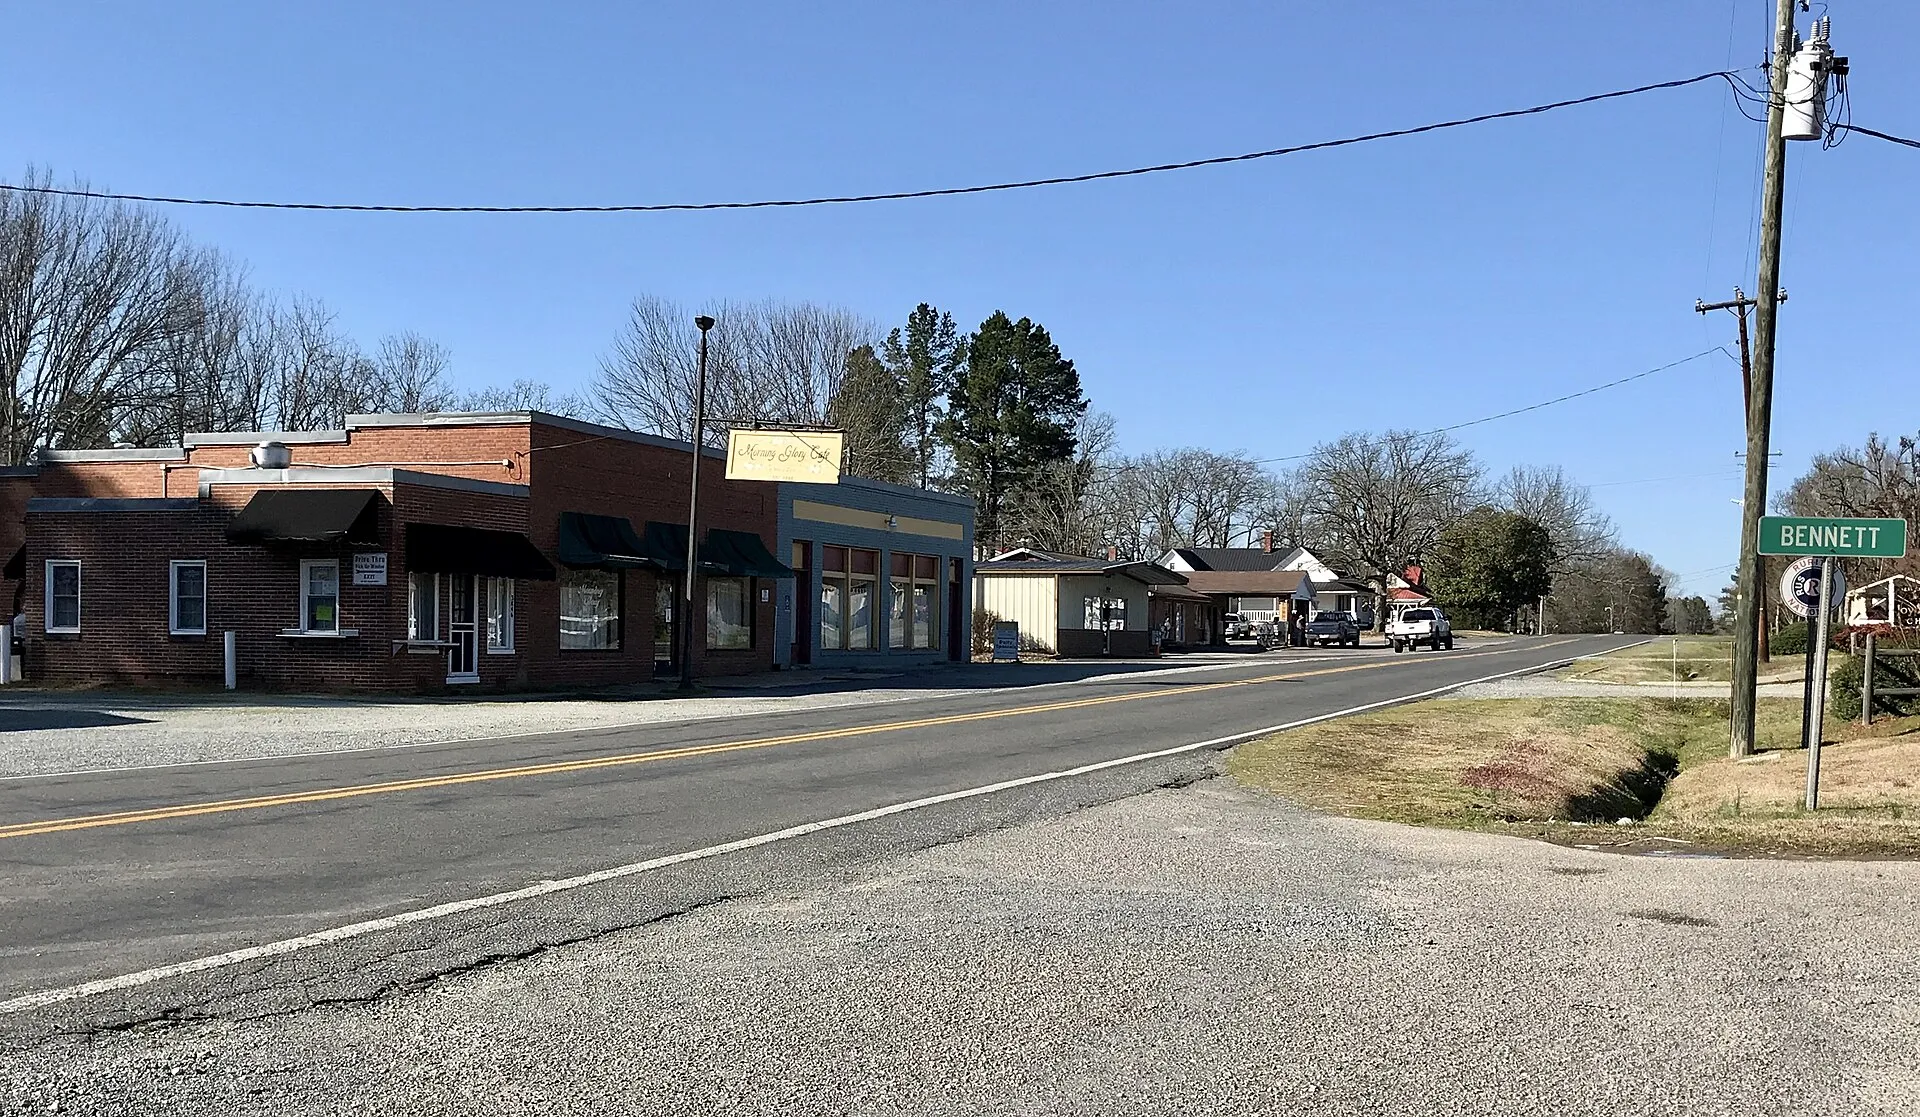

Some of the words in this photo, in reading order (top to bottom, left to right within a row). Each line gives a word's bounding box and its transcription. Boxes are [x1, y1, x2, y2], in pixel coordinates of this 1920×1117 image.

[738, 443, 777, 461] Morning
[778, 444, 807, 462] Glory
[1780, 525, 1880, 549] BENNETT
[371, 555, 385, 563] Thru
[1792, 558, 1824, 571] RURI
[1794, 575, 1806, 597] RUS
[1787, 598, 1820, 616] NATIO
